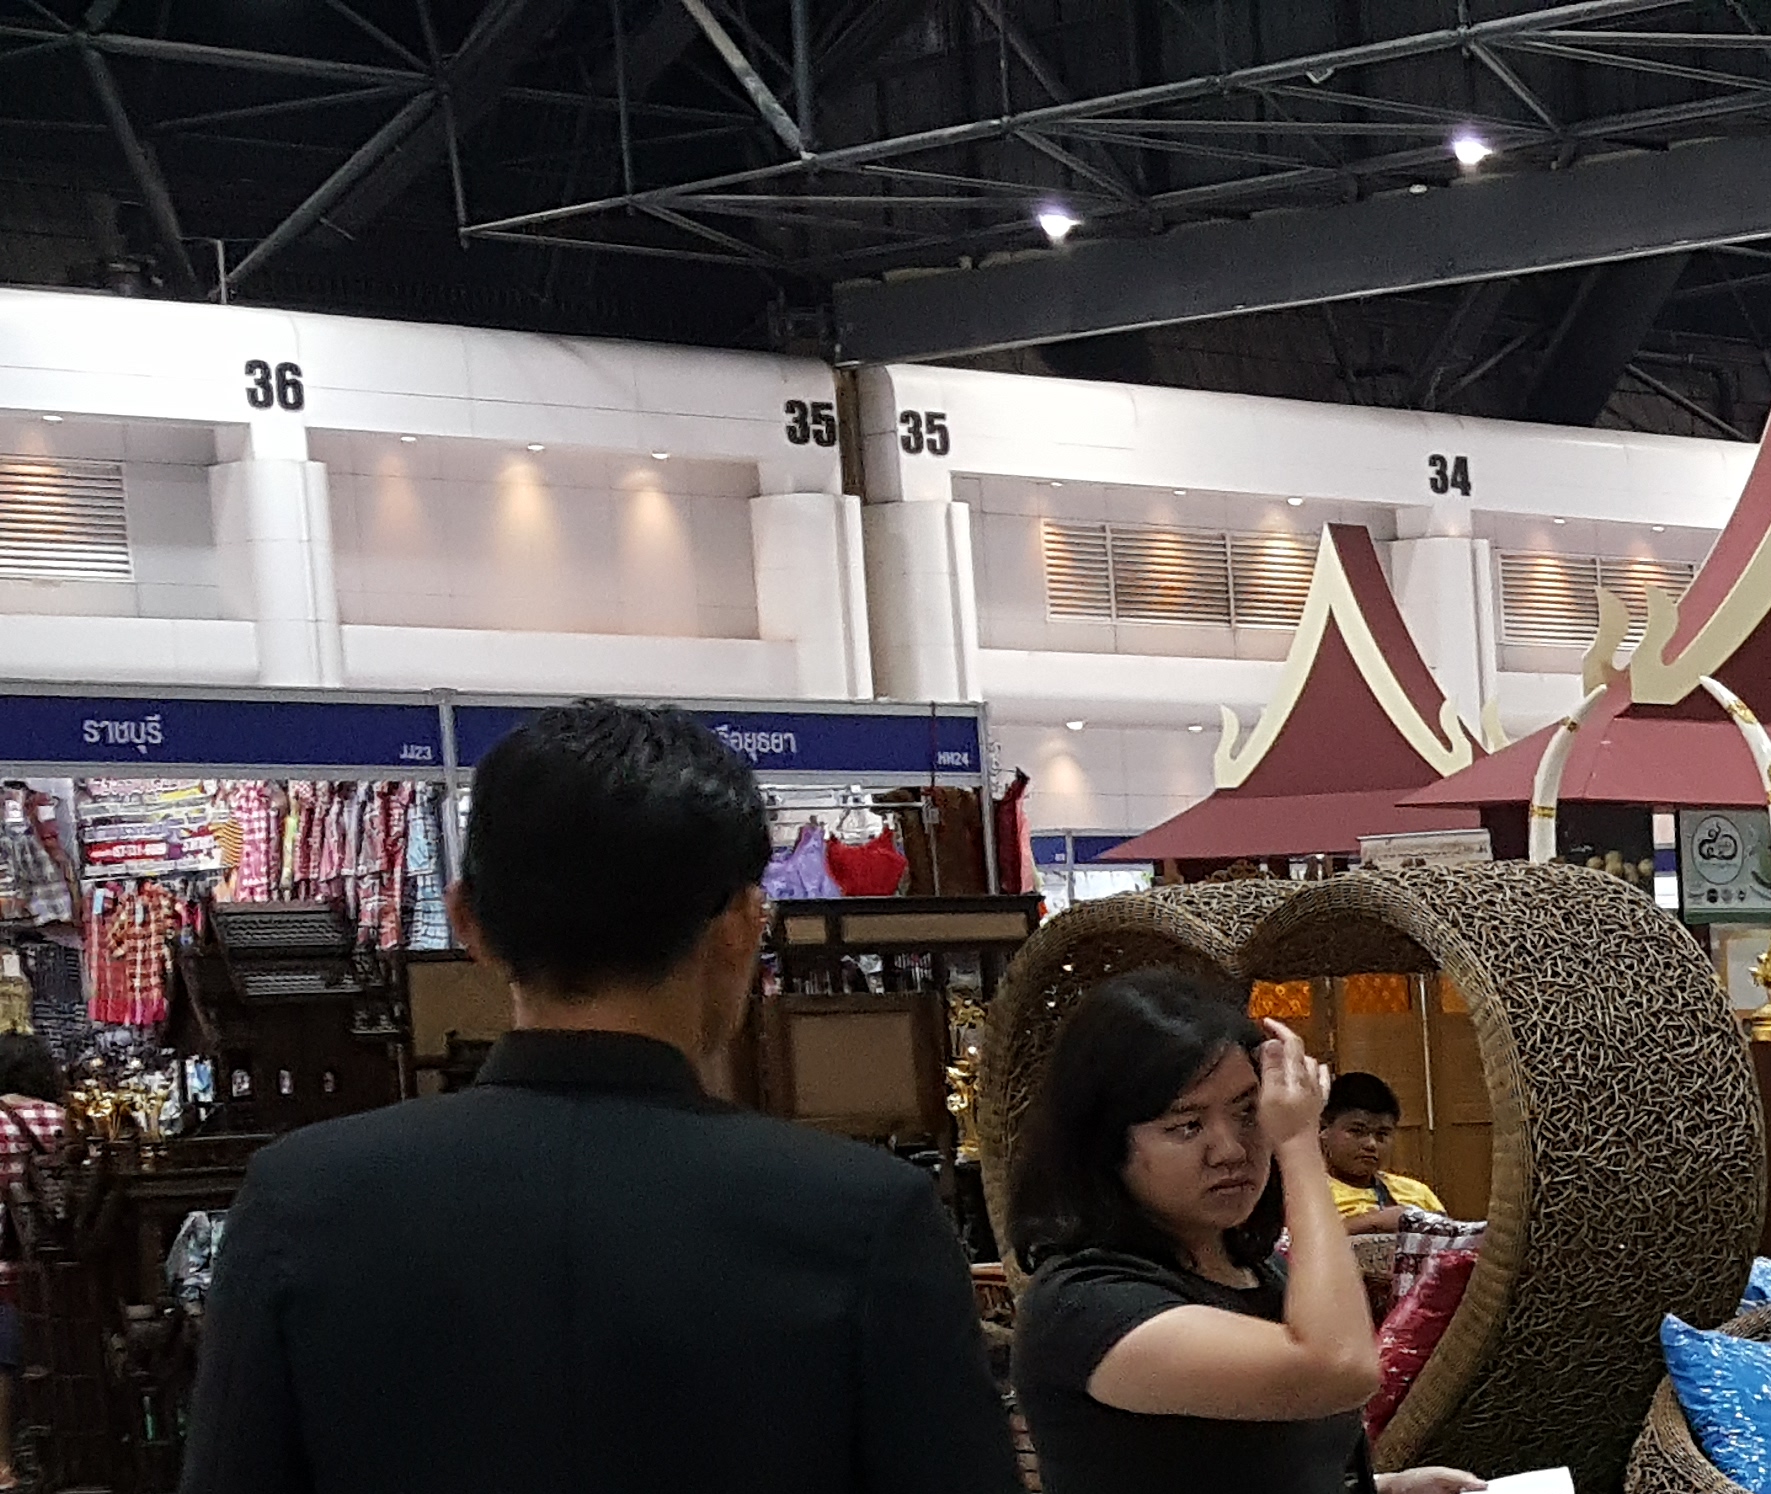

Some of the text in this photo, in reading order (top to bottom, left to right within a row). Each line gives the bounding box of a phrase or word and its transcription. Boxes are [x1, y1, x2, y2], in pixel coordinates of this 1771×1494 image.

[246, 360, 304, 410] 36
[784, 400, 837, 447] 35
[900, 410, 949, 456] 35
[1429, 454, 1472, 496] 34
[82, 714, 163, 754] ราชบุรี
